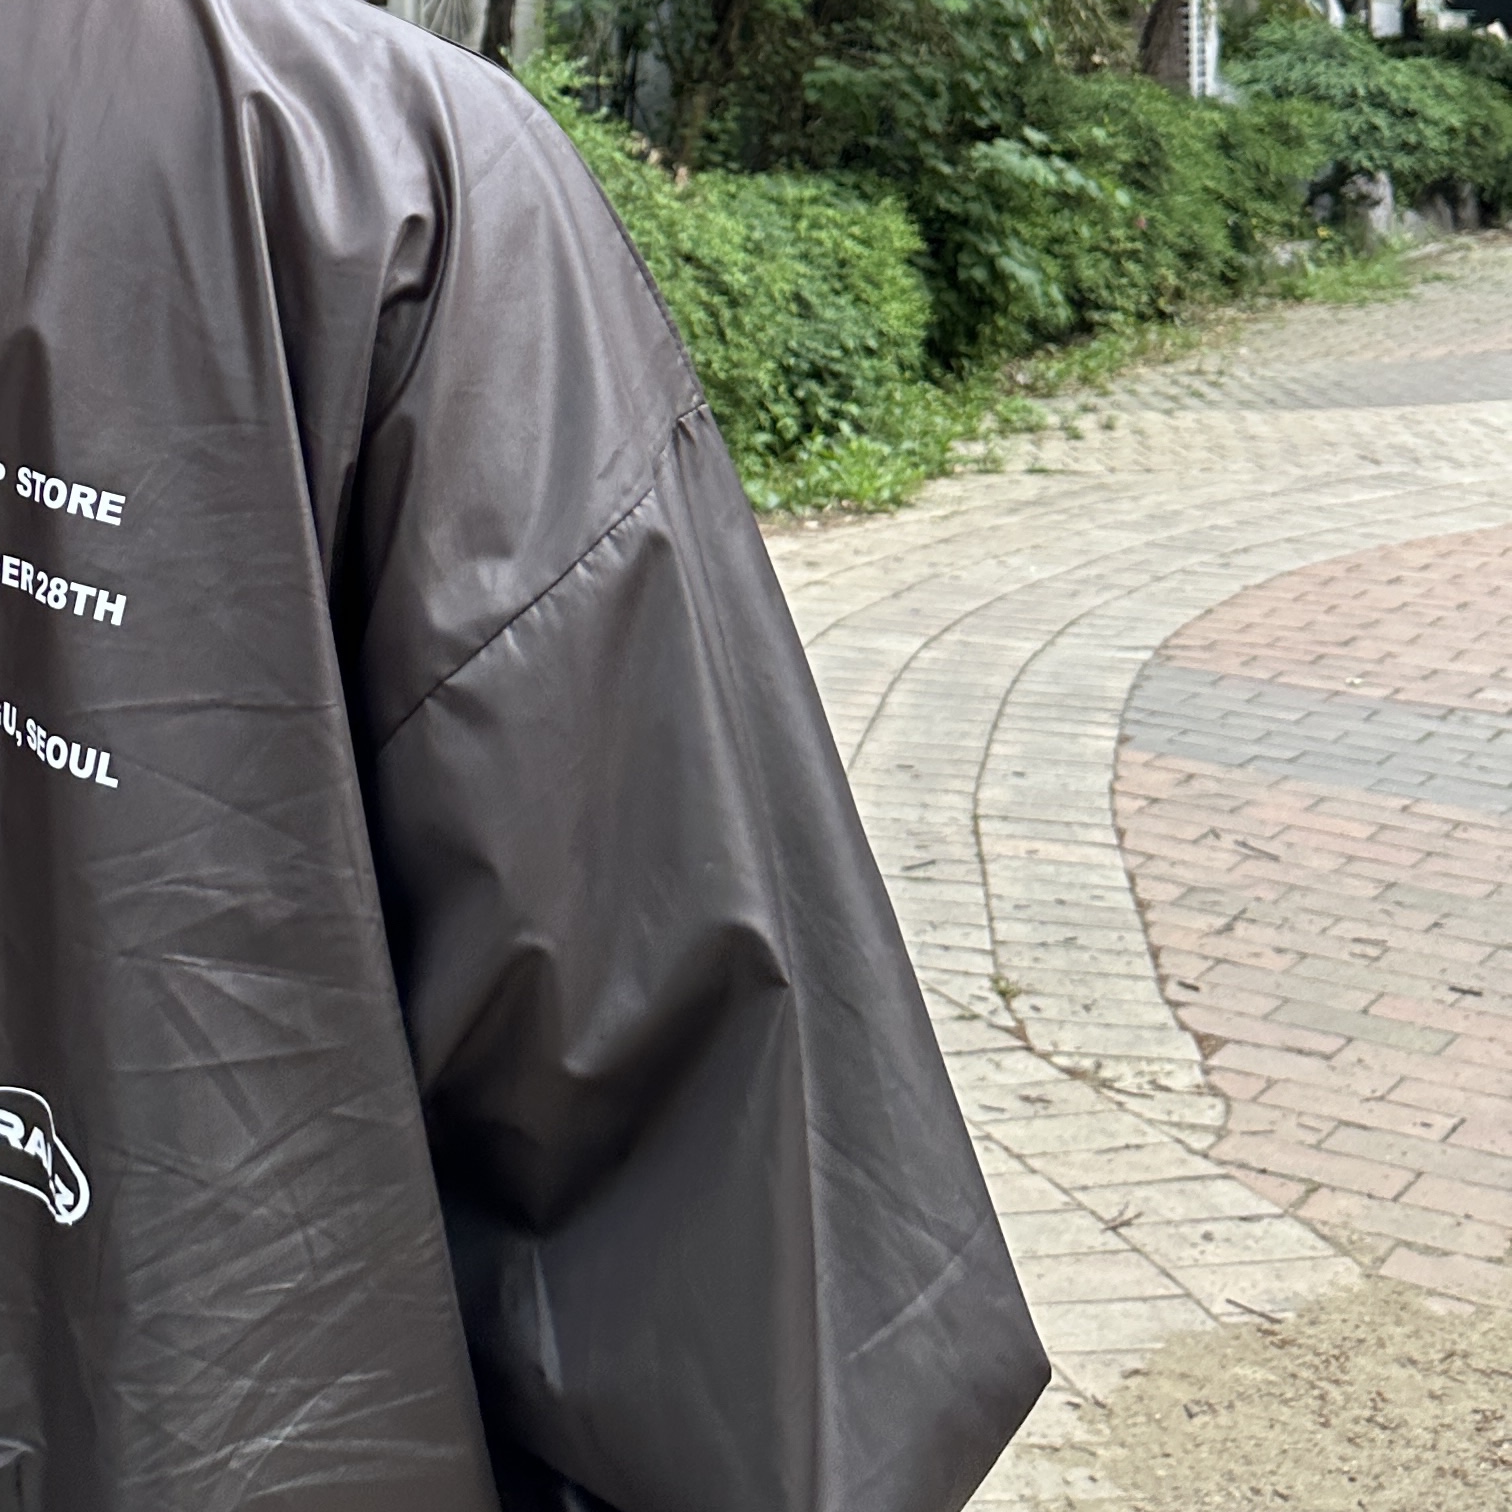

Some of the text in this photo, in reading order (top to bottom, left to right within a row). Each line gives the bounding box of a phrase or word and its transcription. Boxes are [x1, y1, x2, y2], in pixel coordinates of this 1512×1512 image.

[16, 466, 127, 527] STORE
[34, 570, 127, 626] 28TH
[26, 718, 120, 789] SEOUL
